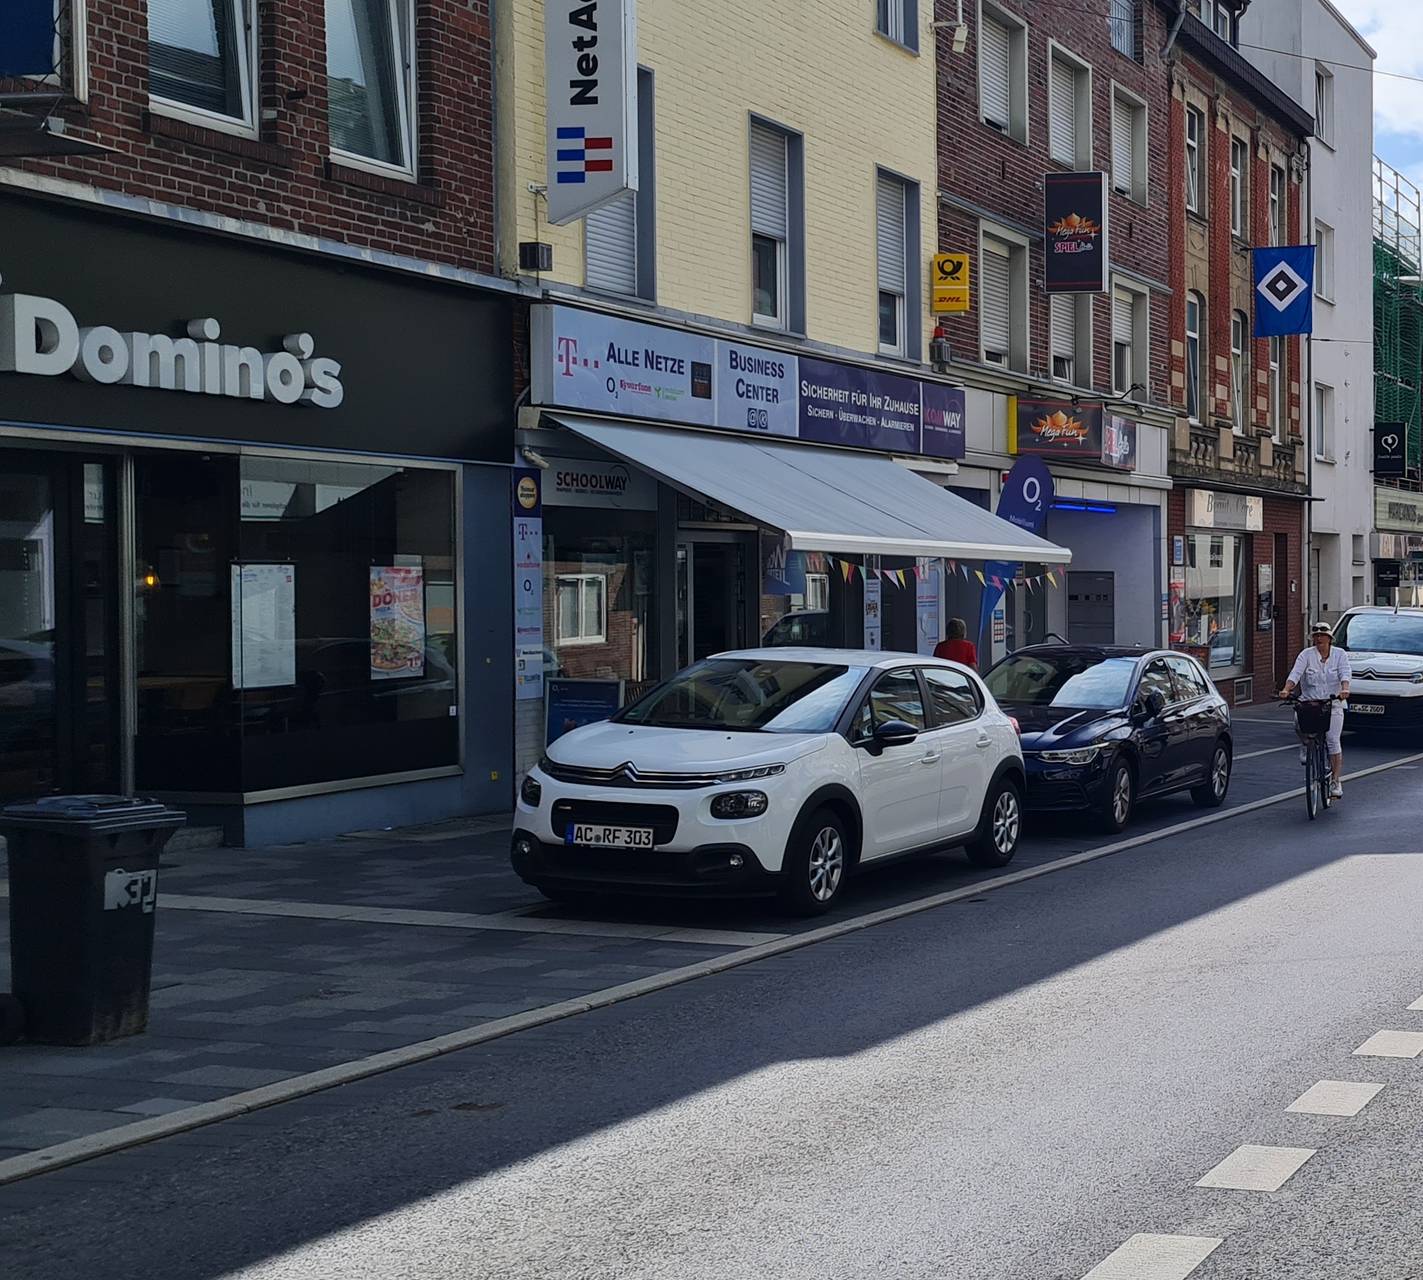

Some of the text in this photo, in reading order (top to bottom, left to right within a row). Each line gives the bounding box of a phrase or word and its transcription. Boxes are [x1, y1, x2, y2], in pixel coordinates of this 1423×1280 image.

[568, 0, 598, 106] NetA
[1056, 224, 1090, 240] Mega Fun
[3, 293, 344, 409] Domino's
[606, 342, 639, 367] ALLE
[644, 349, 685, 375] NETZE
[729, 349, 785, 379] BUSINESS
[735, 378, 779, 405] CENTER
[801, 380, 850, 403] SICHERHEIT
[851, 389, 867, 406] FÜR
[884, 395, 919, 416] ZUHAUSE
[807, 405, 834, 419] SICHERN
[838, 407, 876, 426] ÜBERWACHEN
[880, 417, 914, 432] ALARMIEREN
[1040, 422, 1078, 442] Mega Fun
[556, 471, 628, 490] SCHOOLWAY
[575, 826, 652, 846] AC RF 303
